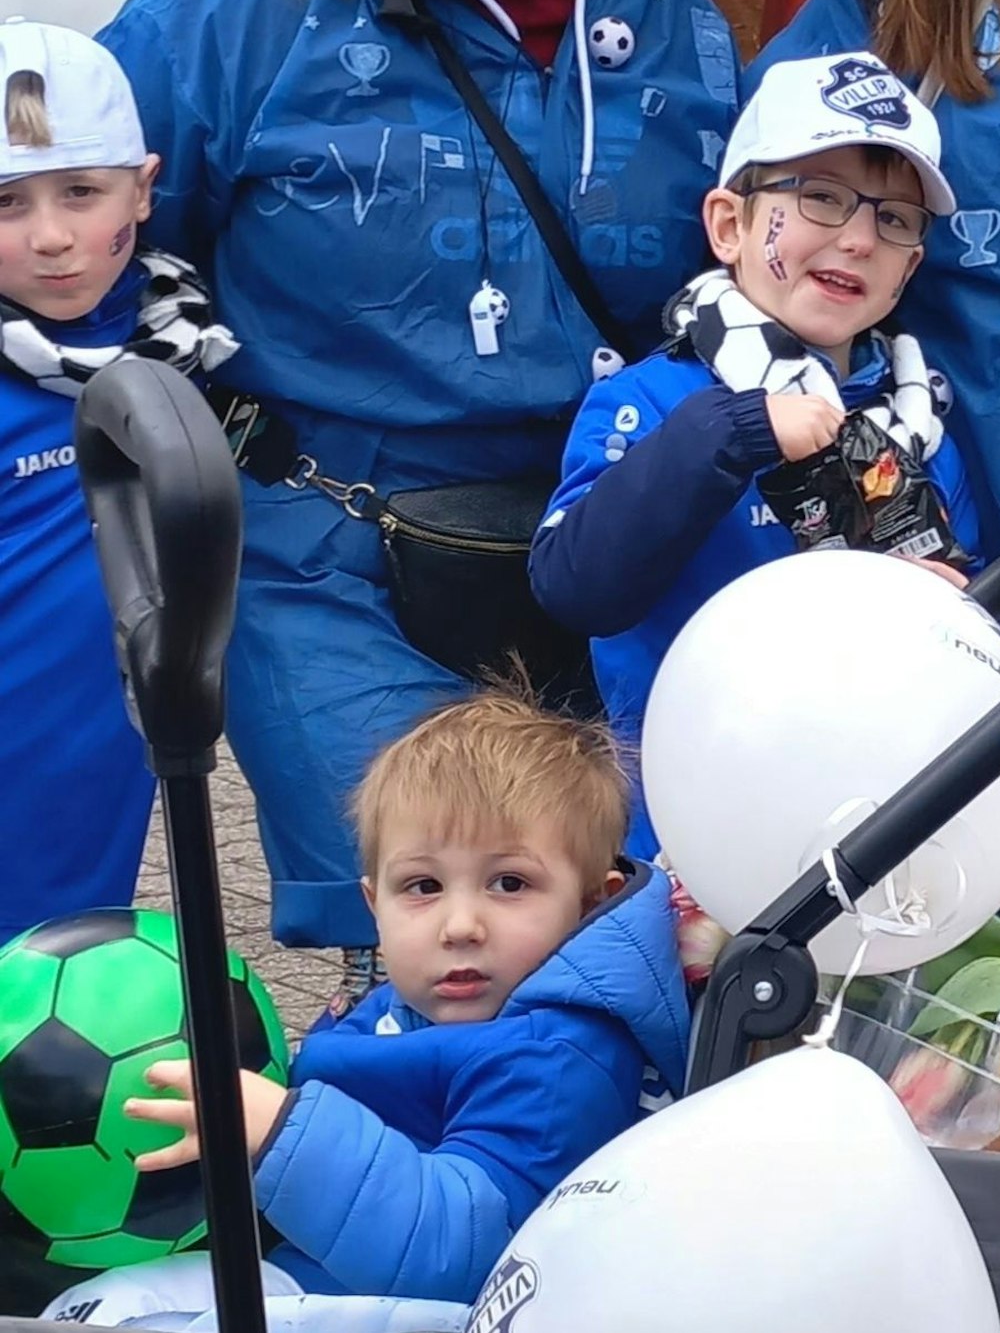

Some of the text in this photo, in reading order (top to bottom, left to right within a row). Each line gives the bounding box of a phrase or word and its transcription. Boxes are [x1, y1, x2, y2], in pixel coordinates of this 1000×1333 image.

[843, 66, 868, 82] SC
[834, 78, 889, 107] VILLIP
[866, 100, 897, 116] 1924
[14, 445, 77, 478] JAKO
